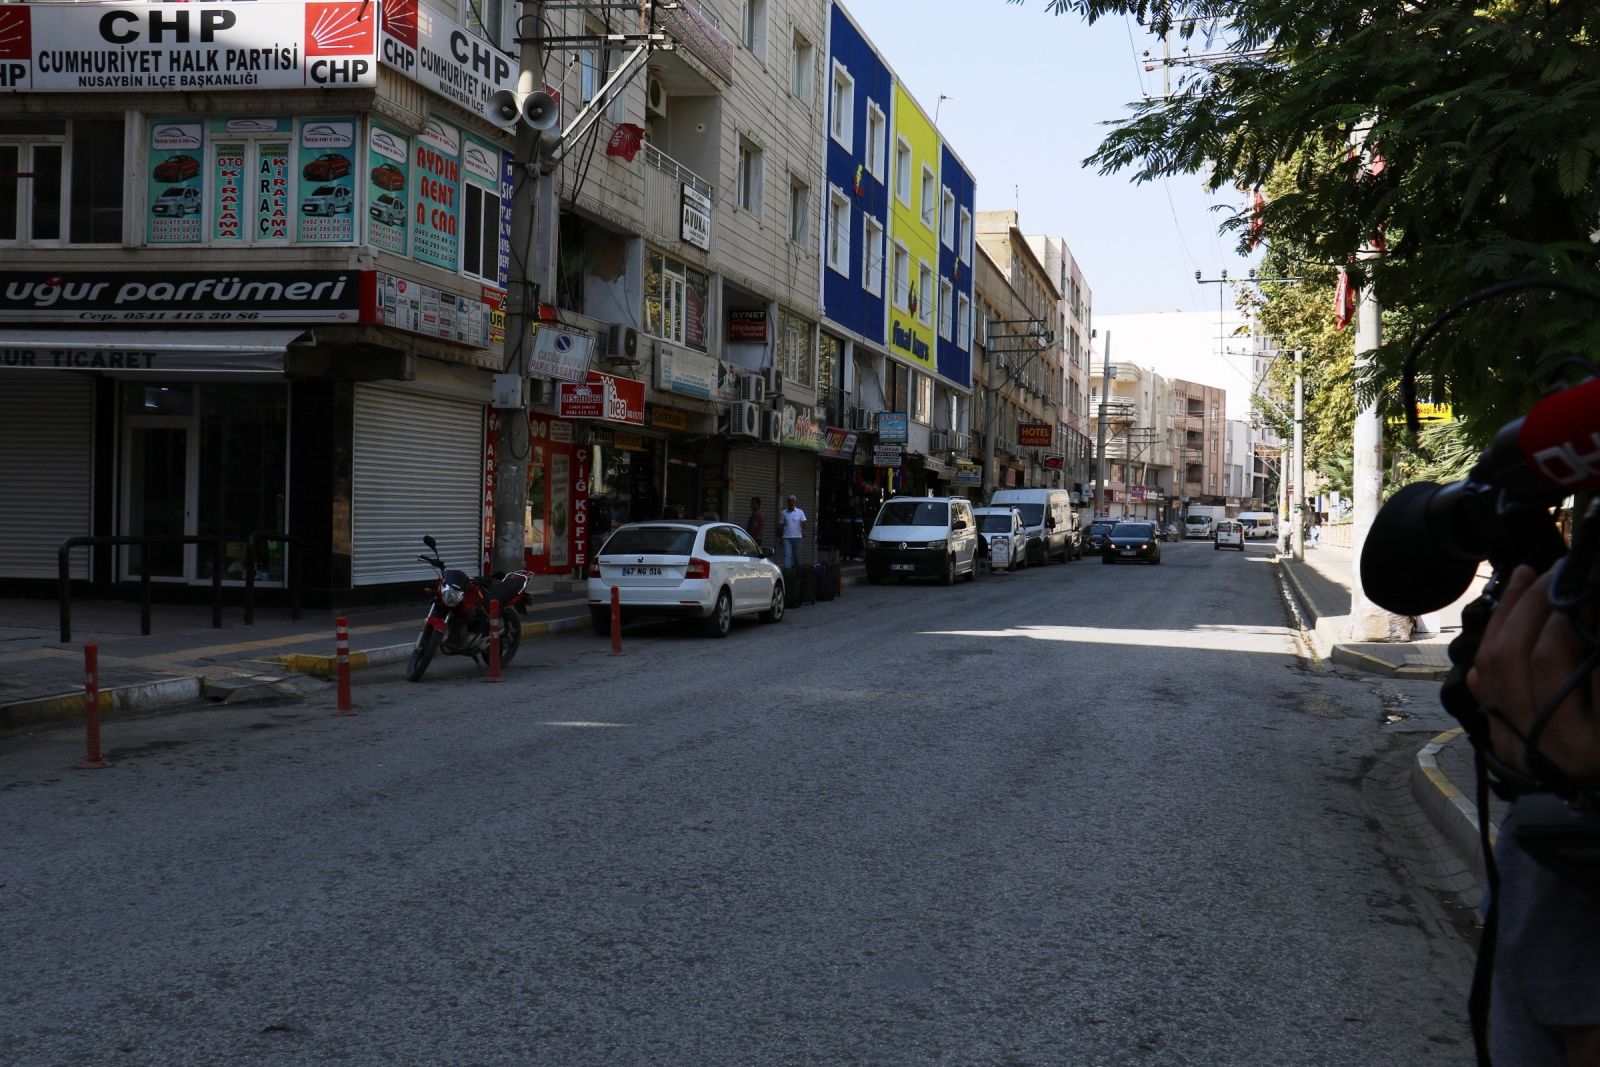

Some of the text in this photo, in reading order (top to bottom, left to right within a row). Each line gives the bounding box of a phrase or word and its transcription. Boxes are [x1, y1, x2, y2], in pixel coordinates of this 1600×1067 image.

[99, 10, 236, 44] CHP
[39, 43, 298, 74] CUMHURİYET HALK PARTİSİ
[384, 38, 415, 72] CHP
[450, 31, 509, 85] CHP
[0, 64, 26, 87] HP
[78, 71, 258, 89] NUSAYBİN İLÇE BAŞKANLIĞI
[310, 60, 369, 84] CHP
[421, 47, 479, 97] CUMHURİYET
[439, 81, 485, 114] NUSAYBİN İLÇE
[218, 158, 243, 167] OTO
[417, 146, 458, 185] AYDIN
[219, 169, 238, 237] KİRALAMA
[260, 159, 270, 236] ARAÇ
[271, 158, 287, 237] KİRALAMA
[421, 175, 454, 209] RENT
[431, 208, 456, 237] CAR
[114, 276, 347, 304] parfümeri
[78, 311, 260, 322] Cep. 0541 415 30 86
[731, 311, 765, 320] AYNET
[1022, 427, 1050, 437] HOTEL
[574, 449, 587, 565] ÇİĞ KÖFTE
[626, 567, 635, 575] 47
[649, 567, 662, 576] 514
